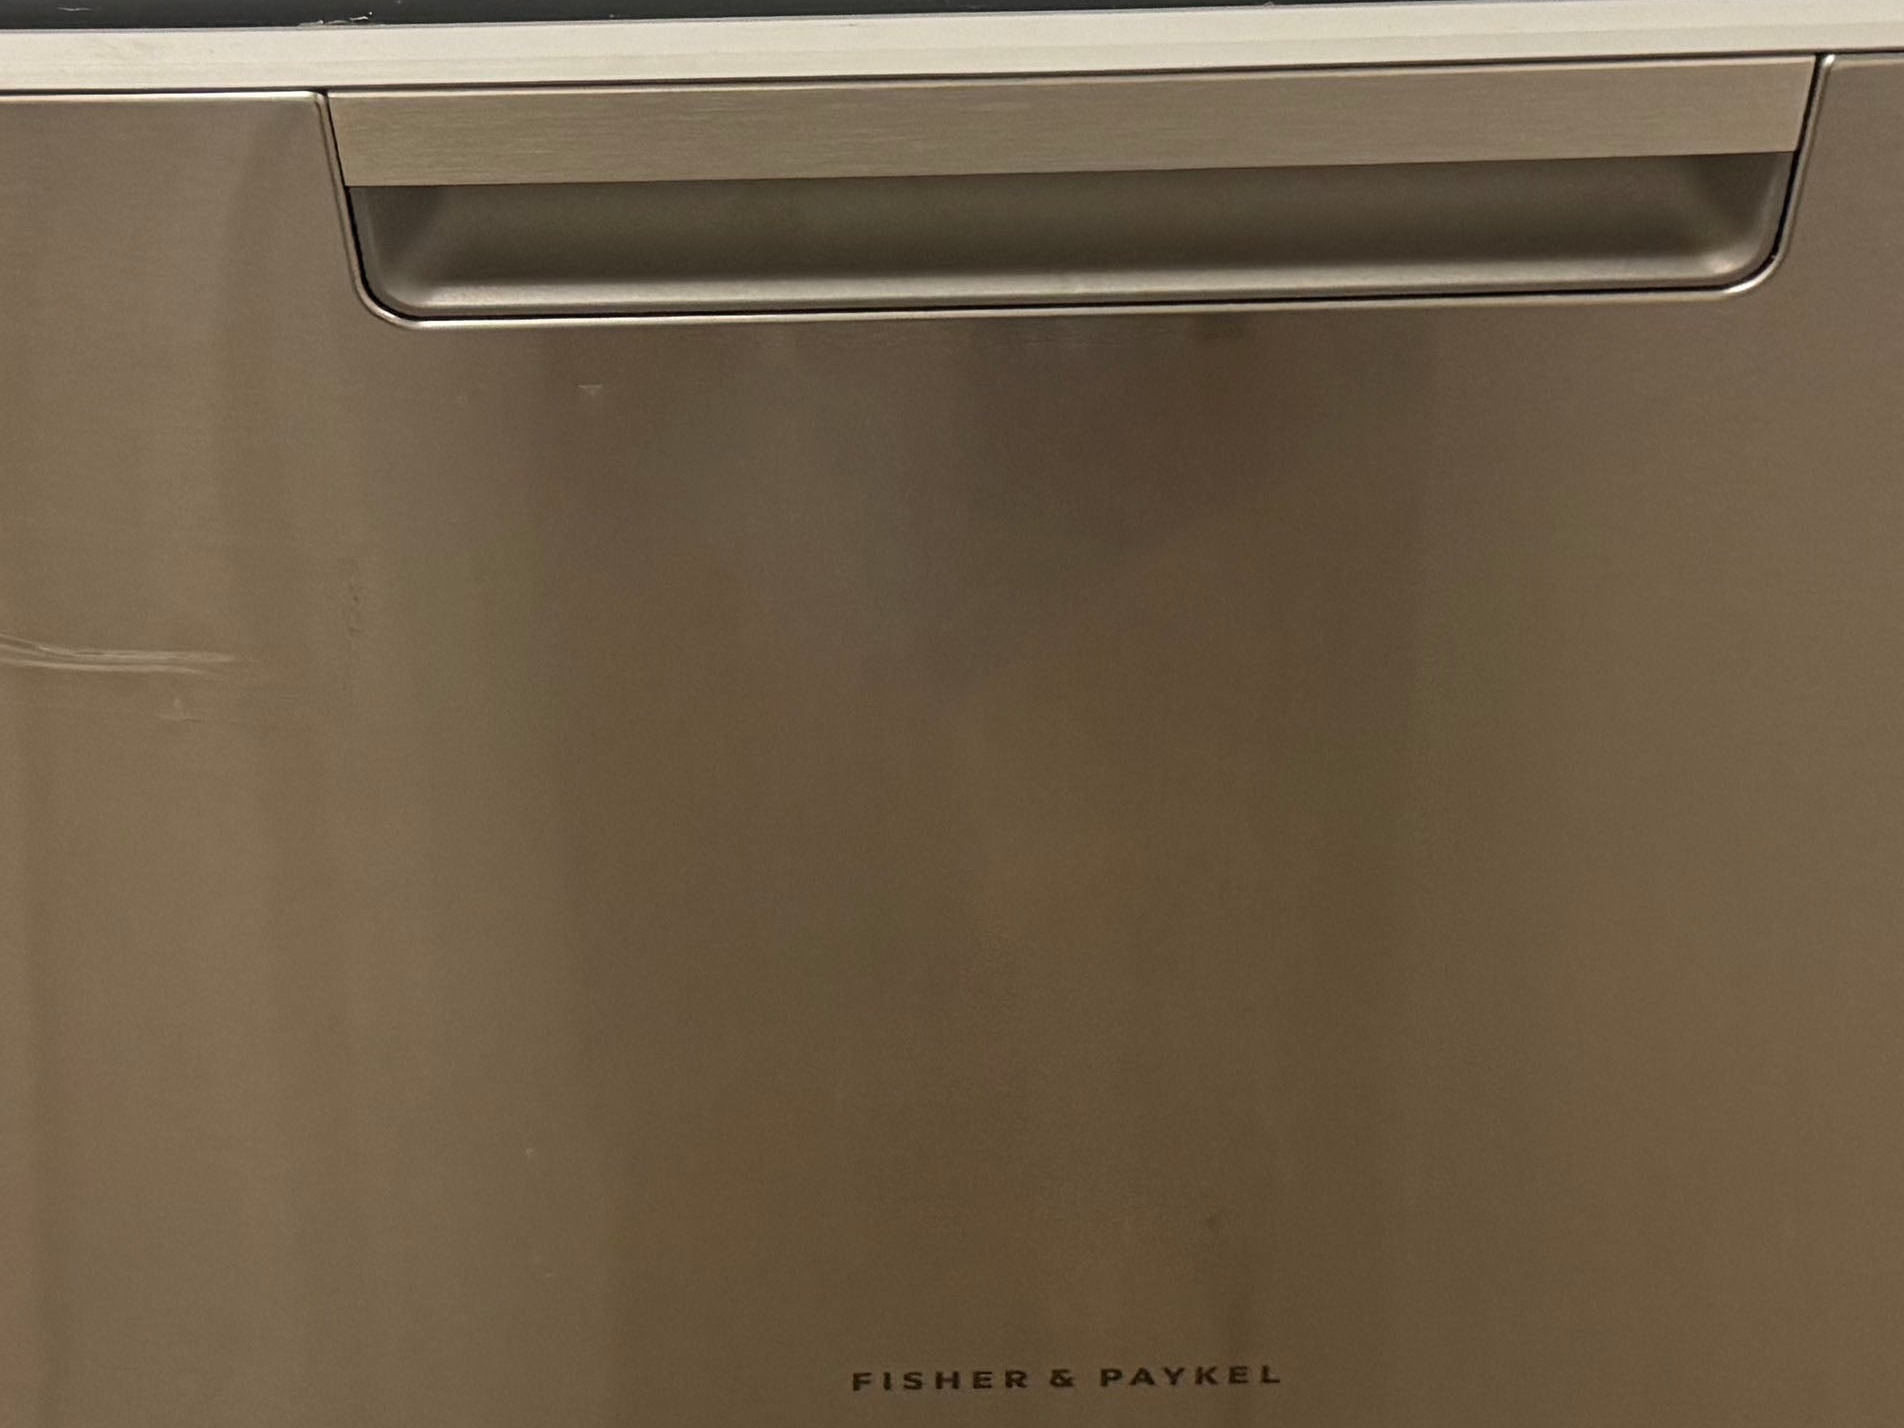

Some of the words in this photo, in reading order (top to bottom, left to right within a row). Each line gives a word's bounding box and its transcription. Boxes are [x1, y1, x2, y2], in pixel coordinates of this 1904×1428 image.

[852, 1372, 1029, 1390] FISHER
[1049, 1369, 1075, 1388] &
[1100, 1367, 1281, 1387] PAYKEL
